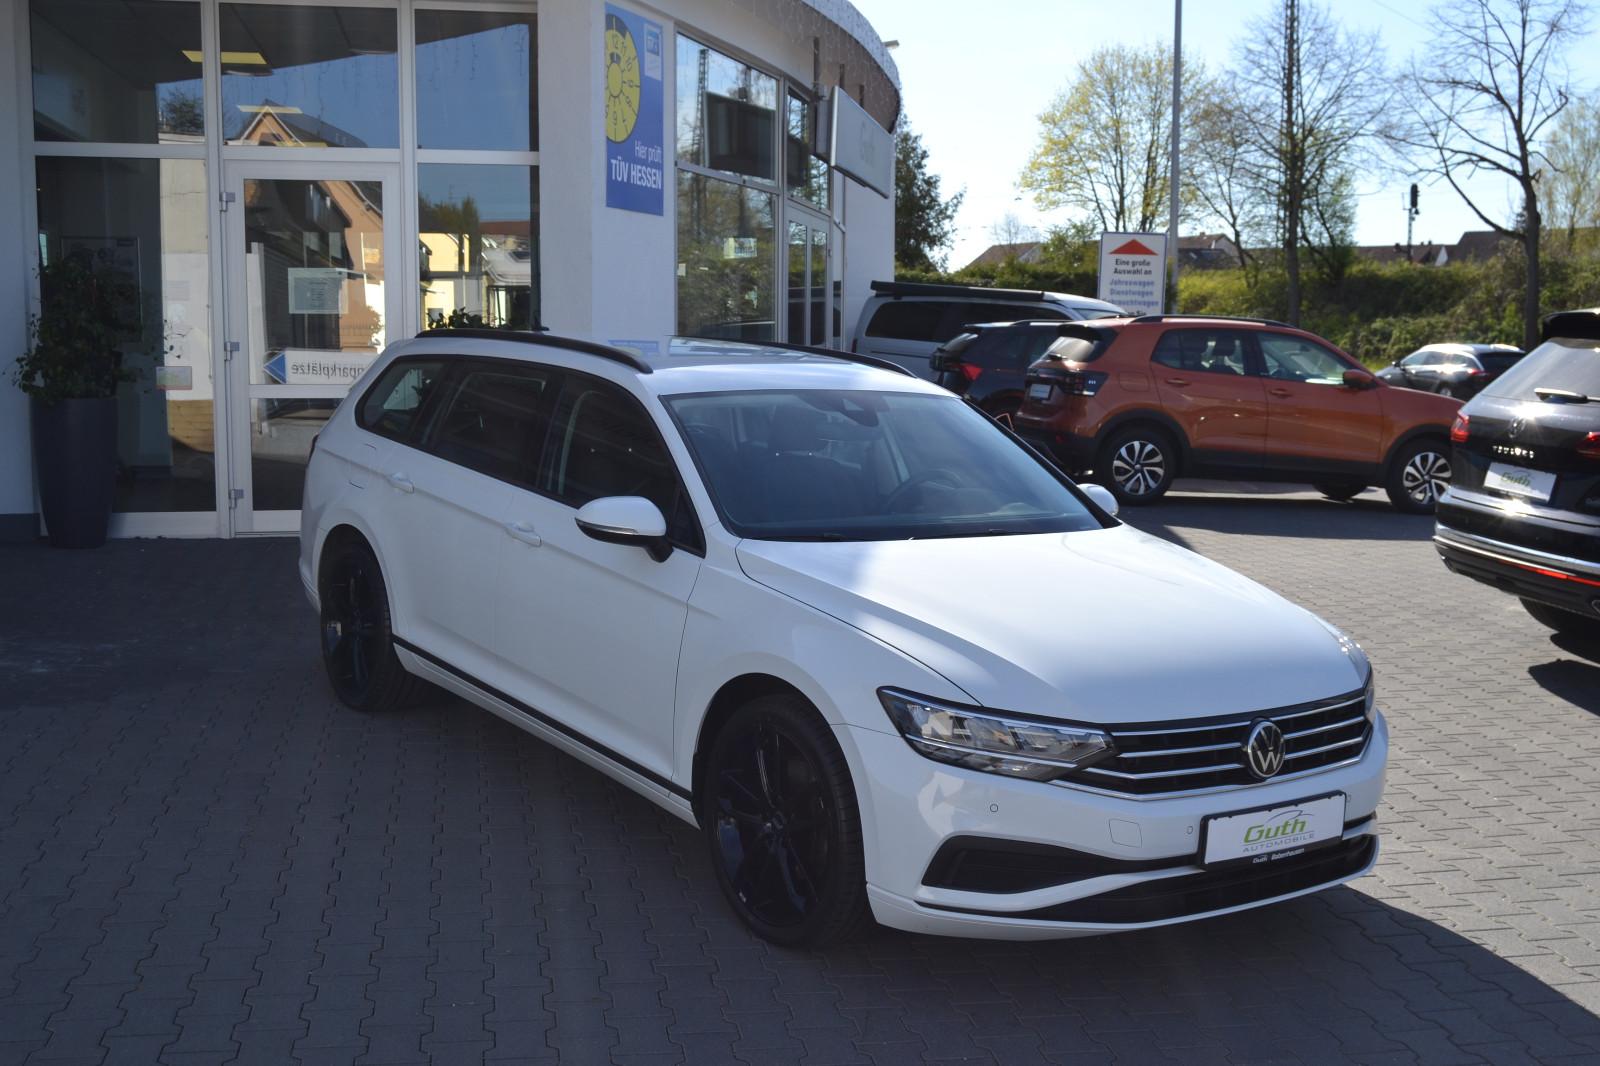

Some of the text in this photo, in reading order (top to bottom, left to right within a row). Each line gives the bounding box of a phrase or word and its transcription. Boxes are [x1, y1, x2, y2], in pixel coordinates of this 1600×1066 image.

[634, 140, 648, 159] Hier
[610, 155, 662, 190] TÜV HESSEN
[1115, 258, 1151, 268] Eine große
[1243, 818, 1307, 844] Guth
[1242, 832, 1315, 853] AUTOMOBILE
